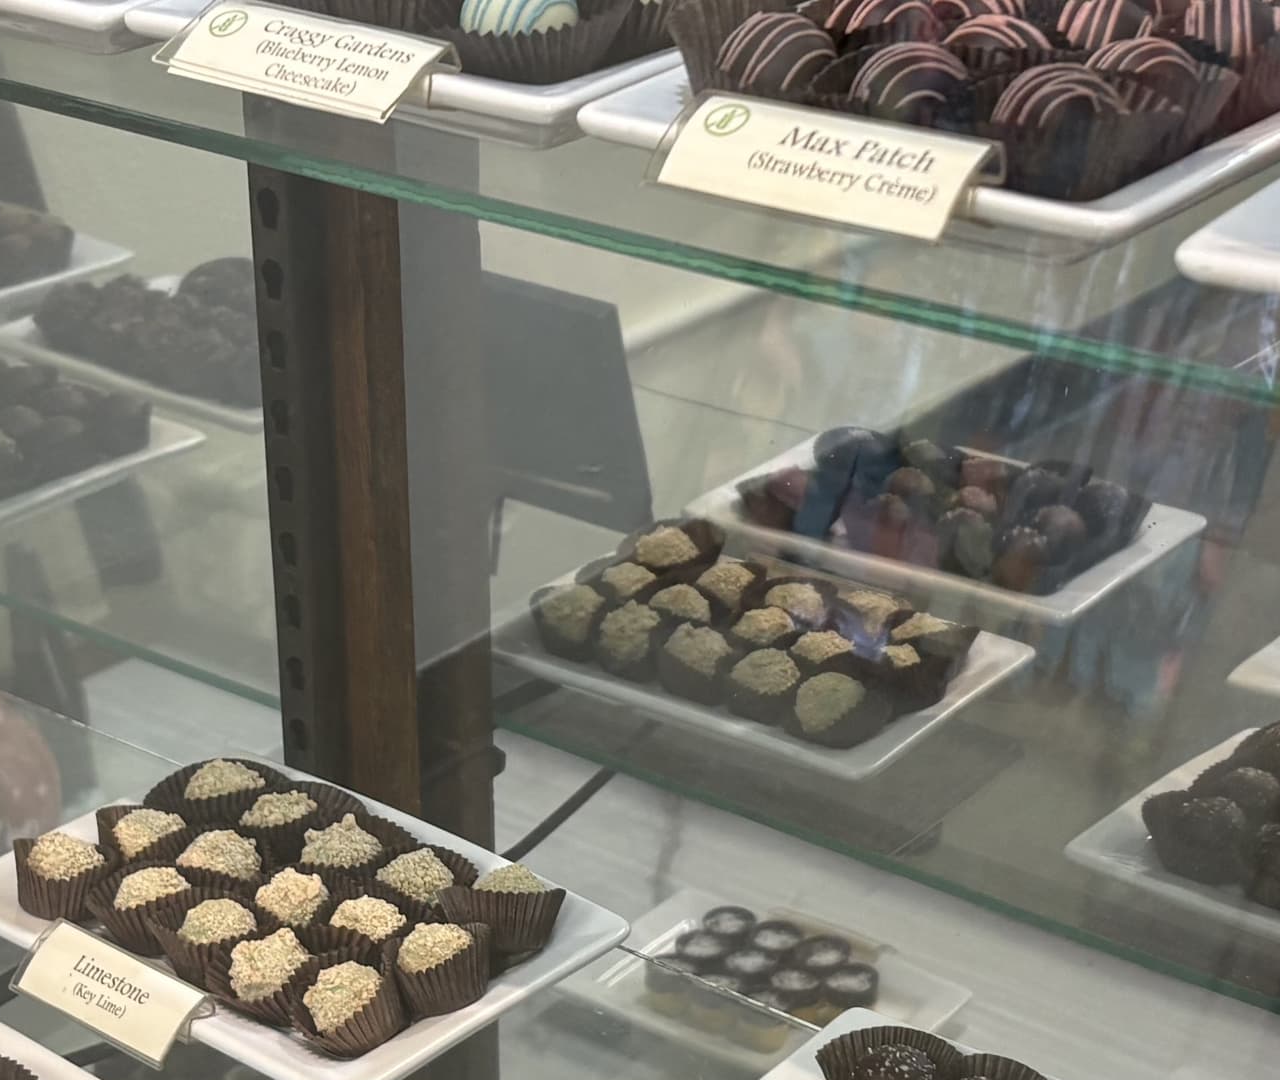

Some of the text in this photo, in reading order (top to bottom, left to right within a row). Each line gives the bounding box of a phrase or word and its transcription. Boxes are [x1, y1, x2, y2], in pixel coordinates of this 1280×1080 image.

[256, 40, 389, 81] (Blueberry Lemon
[264, 19, 415, 64] Craggy Gardens
[264, 63, 357, 96] Cheesecake)
[778, 125, 937, 174] Max Patch
[747, 150, 862, 191] (Strawberry
[72, 982, 127, 1019] (Key Lime)
[73, 954, 150, 1006] Limestone
